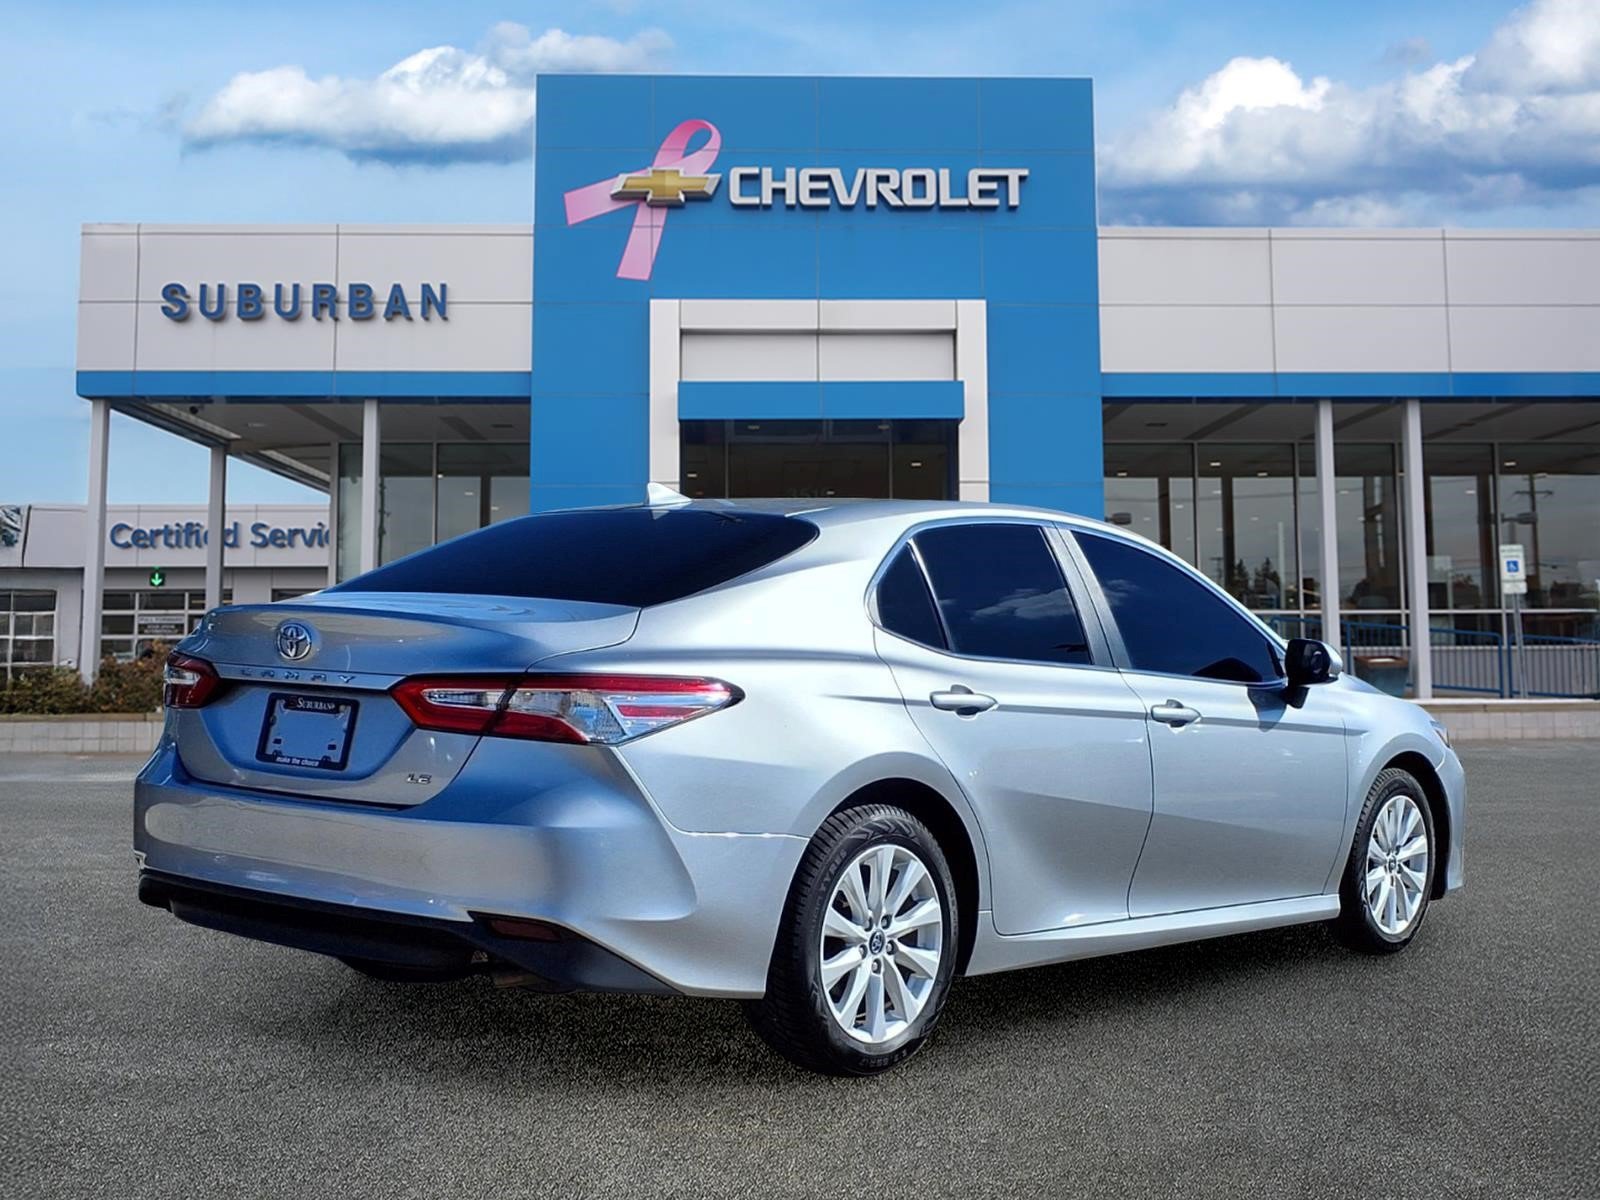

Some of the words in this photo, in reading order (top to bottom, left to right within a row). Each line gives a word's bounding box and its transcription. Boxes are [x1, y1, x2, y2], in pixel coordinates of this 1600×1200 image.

[729, 166, 1029, 207] CHEVROLET
[161, 282, 448, 321] SUBURBAN
[110, 521, 240, 549] Certifid
[250, 521, 329, 549] Servi
[291, 757, 301, 765] the
